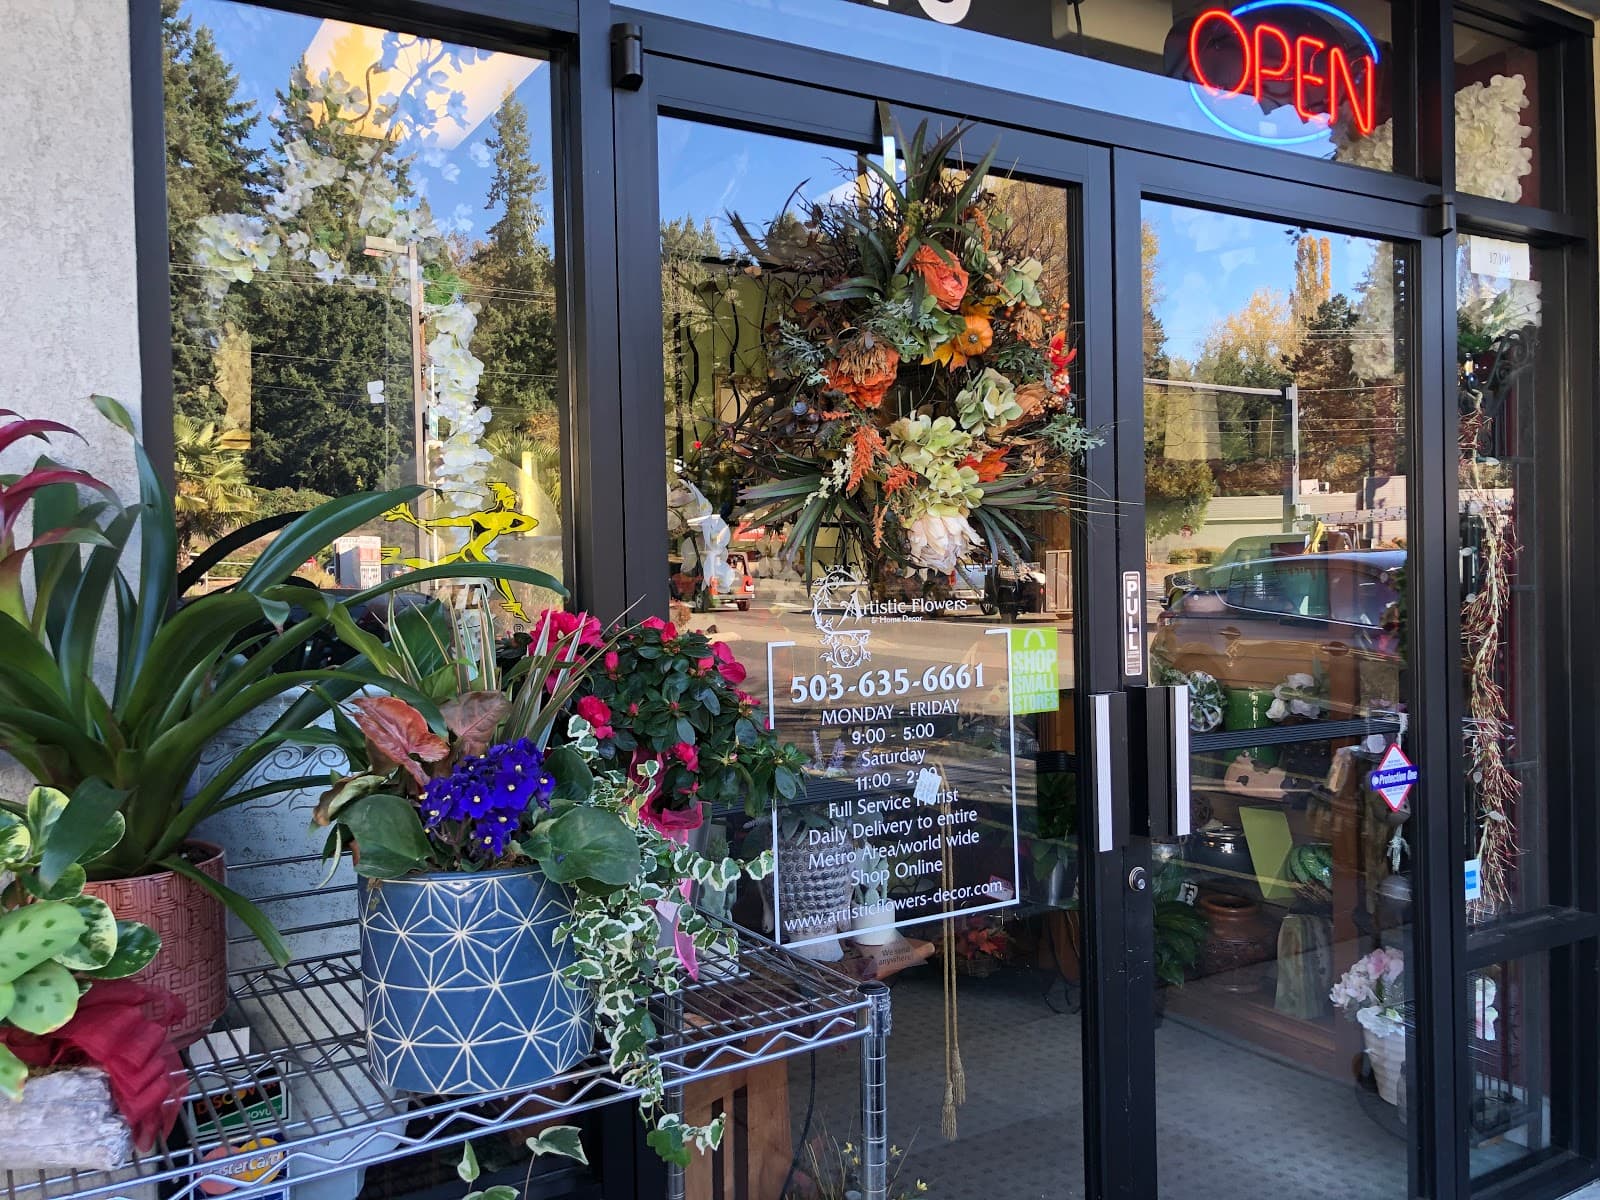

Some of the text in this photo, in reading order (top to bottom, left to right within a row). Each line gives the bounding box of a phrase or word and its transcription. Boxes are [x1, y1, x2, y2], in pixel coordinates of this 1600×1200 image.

[1188, 8, 1375, 137] OPEN
[838, 588, 968, 625] Artistic Flowers
[879, 615, 901, 624] Home
[902, 614, 923, 623] Decor
[1126, 580, 1139, 650] PULL
[1013, 649, 1057, 675] SHOP
[791, 662, 984, 703] 503-635-6661
[820, 704, 895, 726] MONDAY
[910, 698, 960, 717] FRIDAY
[851, 728, 886, 745] 9:00
[903, 722, 935, 739] 5:00
[861, 747, 926, 767] Saturday
[855, 772, 892, 792] 11:00
[828, 788, 959, 819] Full Service rist
[808, 807, 978, 848] Daily Delivery to entire
[808, 829, 980, 870] Metro Area/world wide
[851, 857, 943, 887] Shop Online
[784, 879, 1003, 932] www.artisticflowers-decor.com
[196, 1080, 278, 1115] DSCOV
[200, 1152, 282, 1177] sterCard
